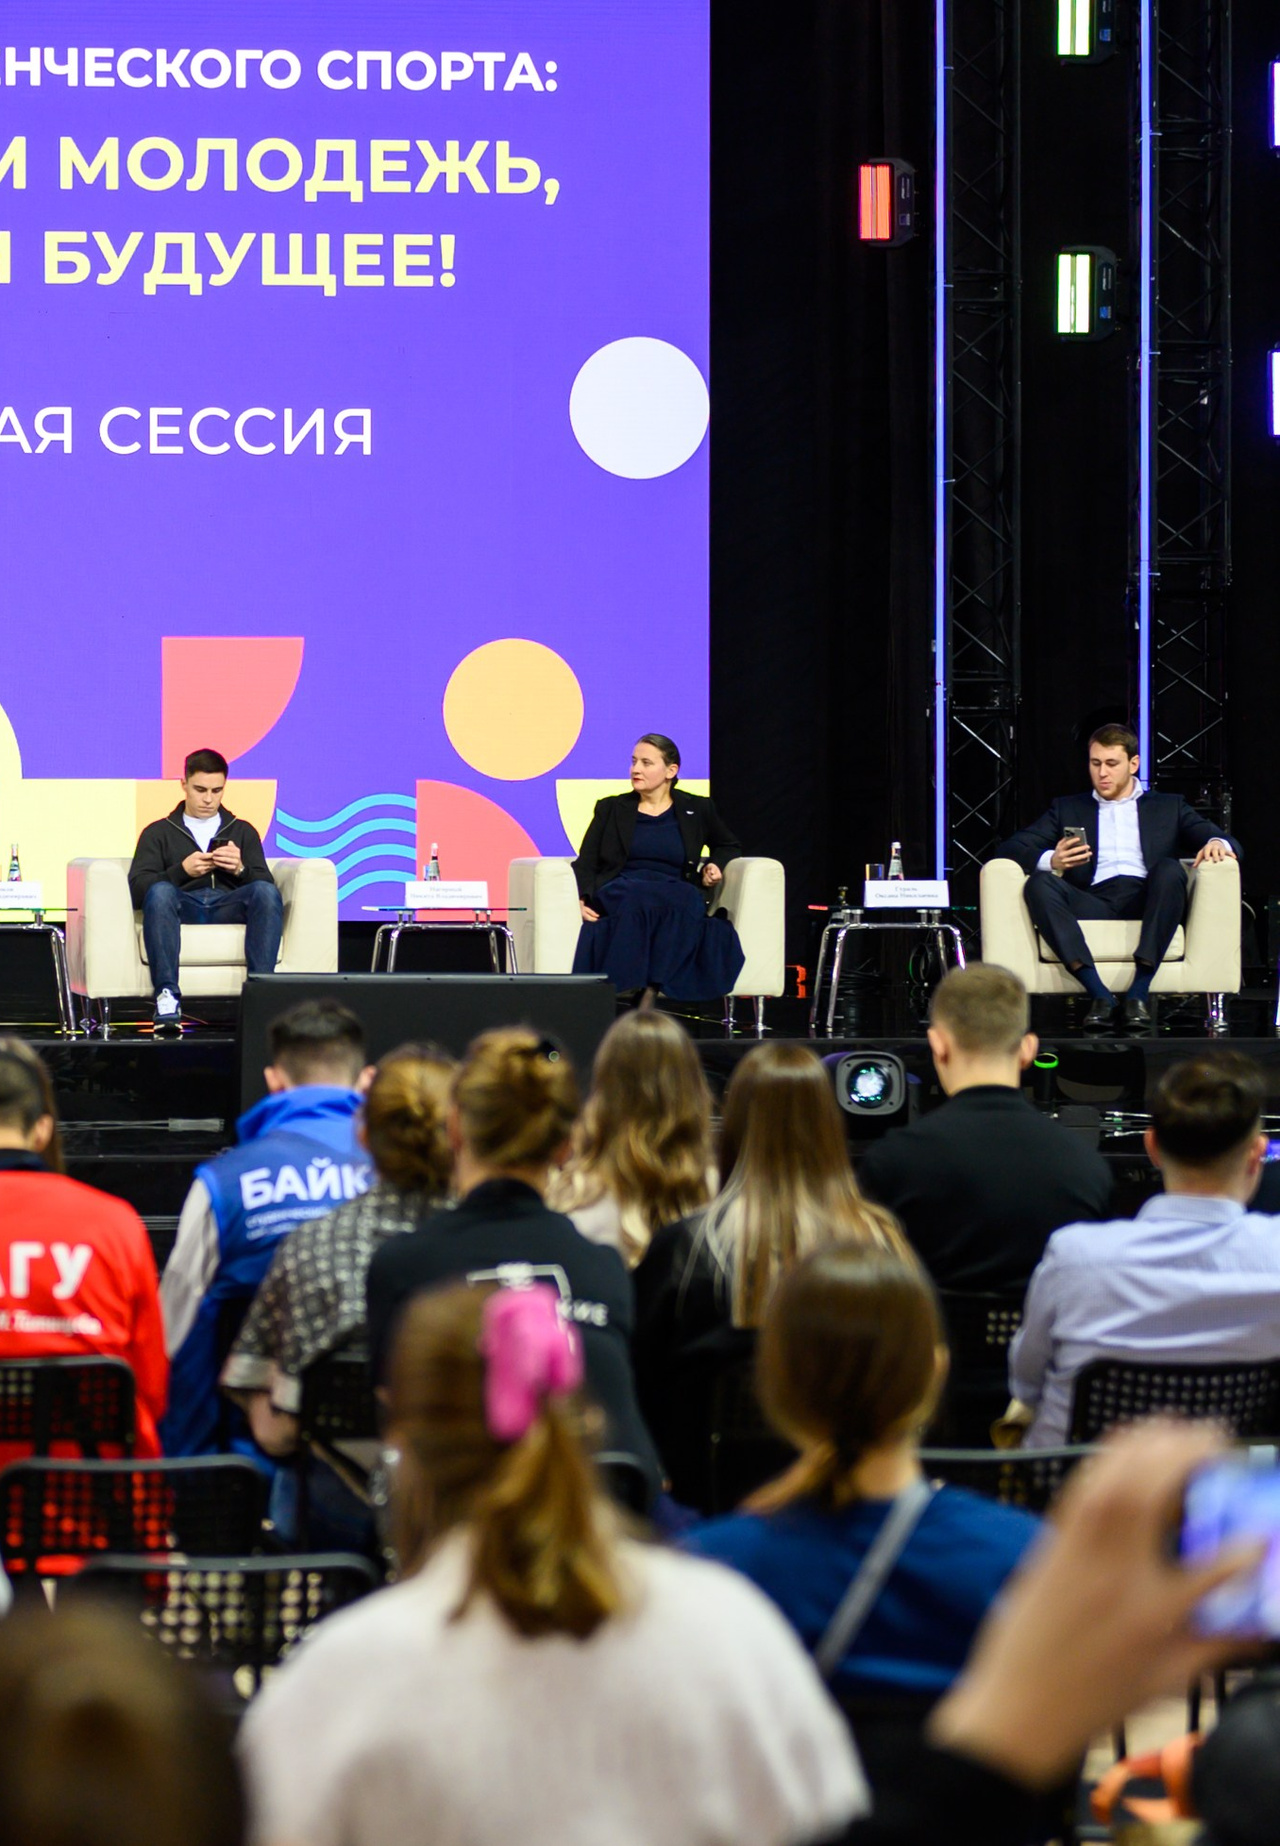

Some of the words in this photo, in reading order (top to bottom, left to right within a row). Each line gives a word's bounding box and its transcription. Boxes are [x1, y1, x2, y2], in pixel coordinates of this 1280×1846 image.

[317, 49, 558, 92] СПОРТА:
[59, 136, 560, 206] МОЛОДЕЖЬ,
[44, 230, 456, 297] БУДУЩЕЕ!
[99, 406, 372, 456] СЕССИЯ
